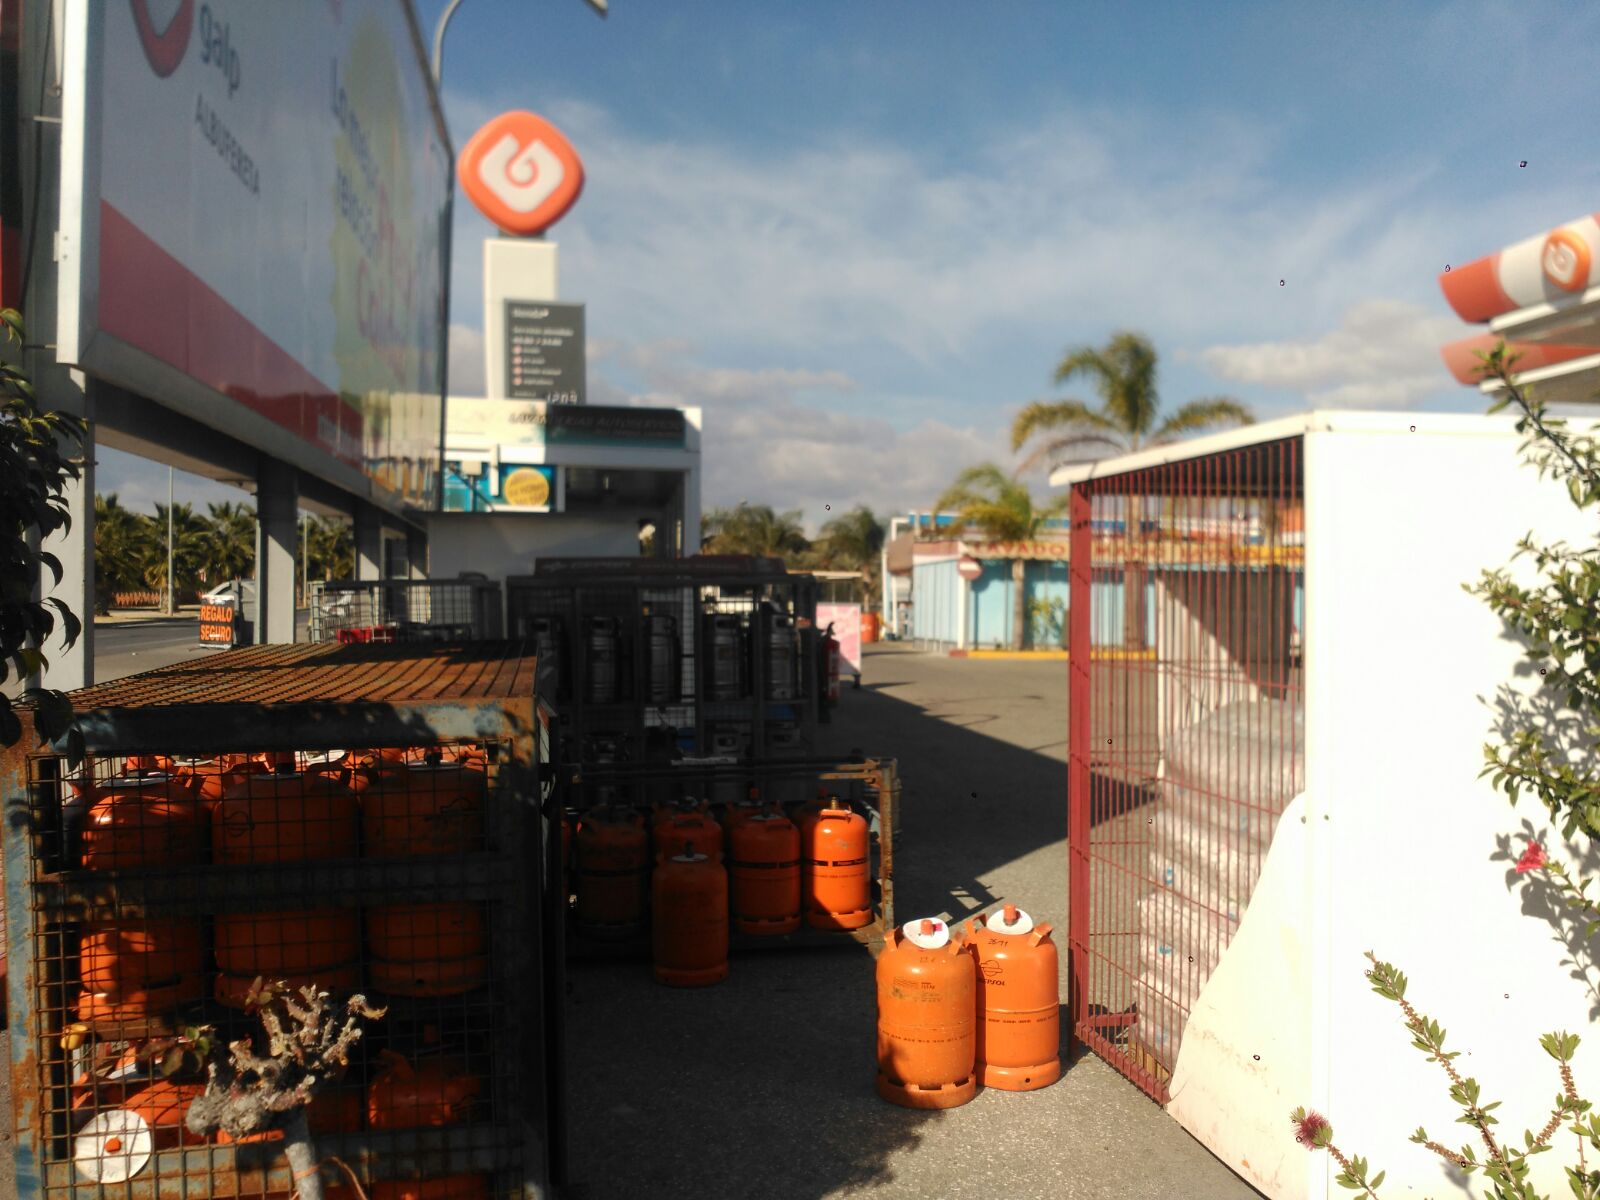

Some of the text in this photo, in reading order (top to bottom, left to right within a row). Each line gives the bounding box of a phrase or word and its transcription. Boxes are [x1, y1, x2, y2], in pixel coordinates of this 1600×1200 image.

[199, 1, 241, 97] galp
[976, 540, 1066, 556] LAVADO
[200, 605, 233, 622] REGALO
[200, 624, 232, 641] SEGURO
